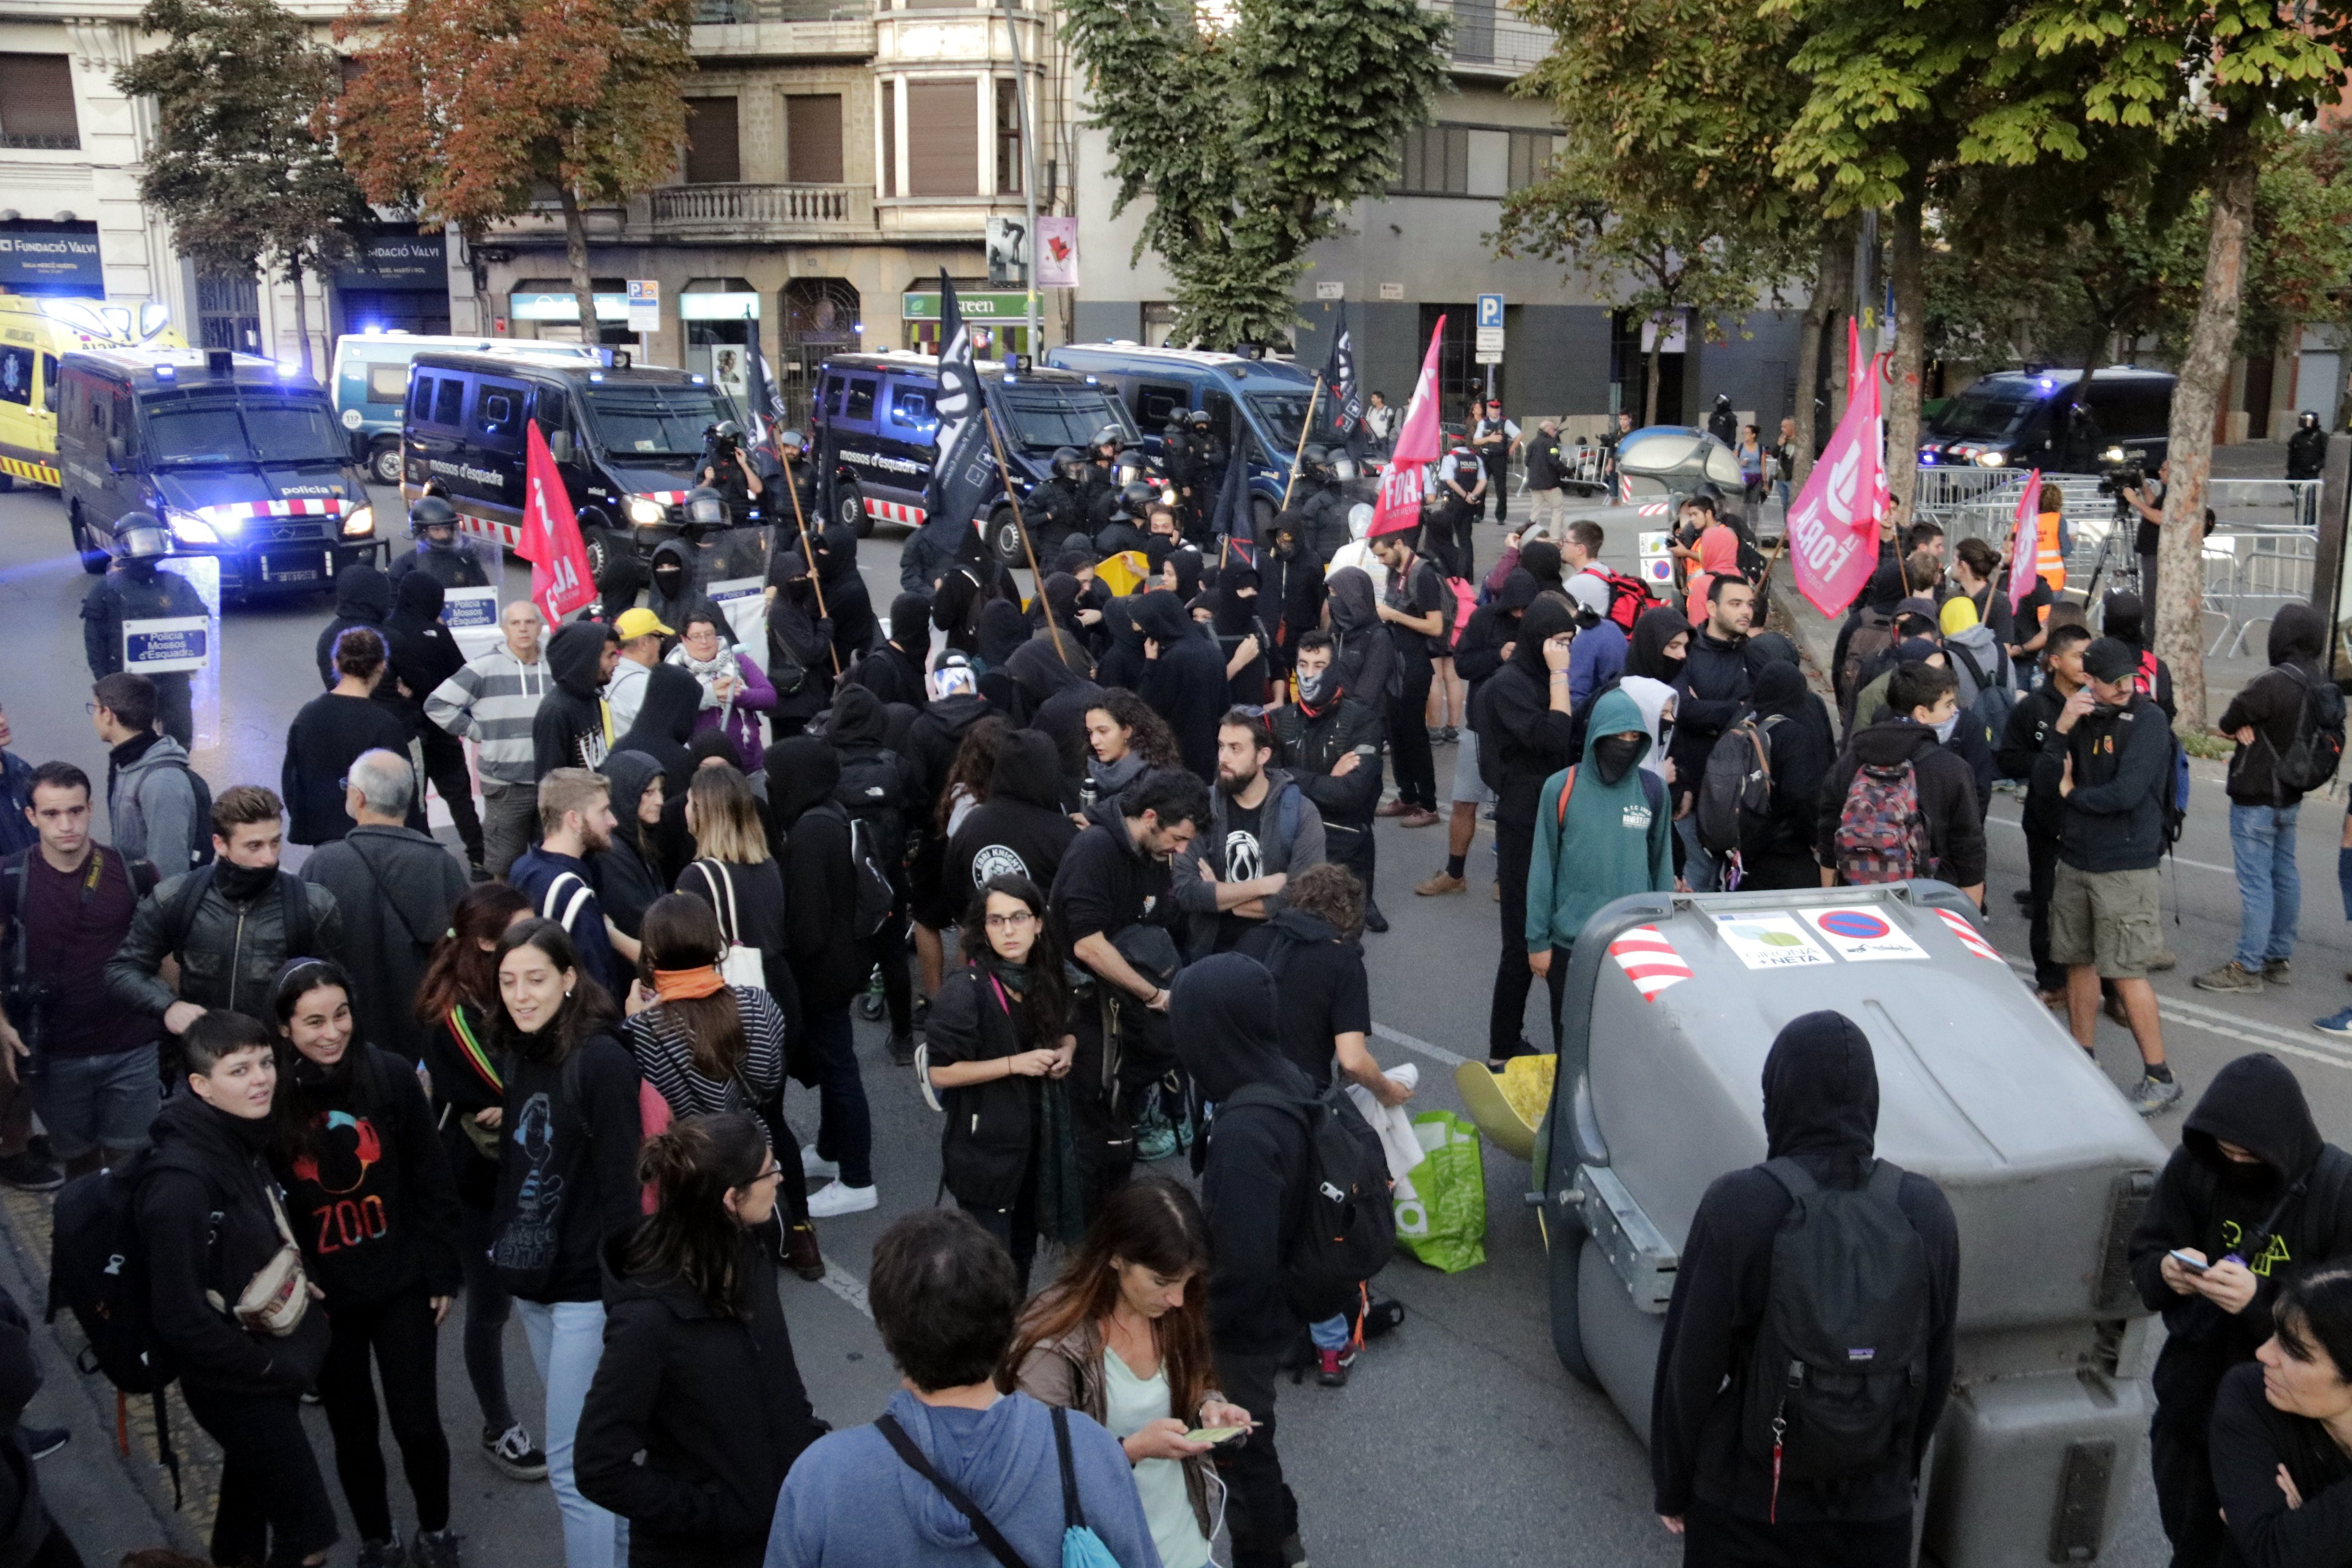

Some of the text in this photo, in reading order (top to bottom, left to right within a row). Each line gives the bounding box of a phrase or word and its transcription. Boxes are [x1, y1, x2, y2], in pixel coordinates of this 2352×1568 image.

[410, 245, 439, 257] VALVI
[630, 283, 640, 296] P
[1482, 298, 1498, 324] P
[840, 449, 916, 475] mossos d'esquadra
[430, 459, 459, 476] mossos
[460, 462, 503, 486] d'esquadra
[281, 485, 329, 496] policia
[150, 633, 184, 641] Policia
[148, 641, 186, 650] Mossos
[1746, 948, 1820, 959] GIRONA
[312, 1195, 387, 1254] ZOO
